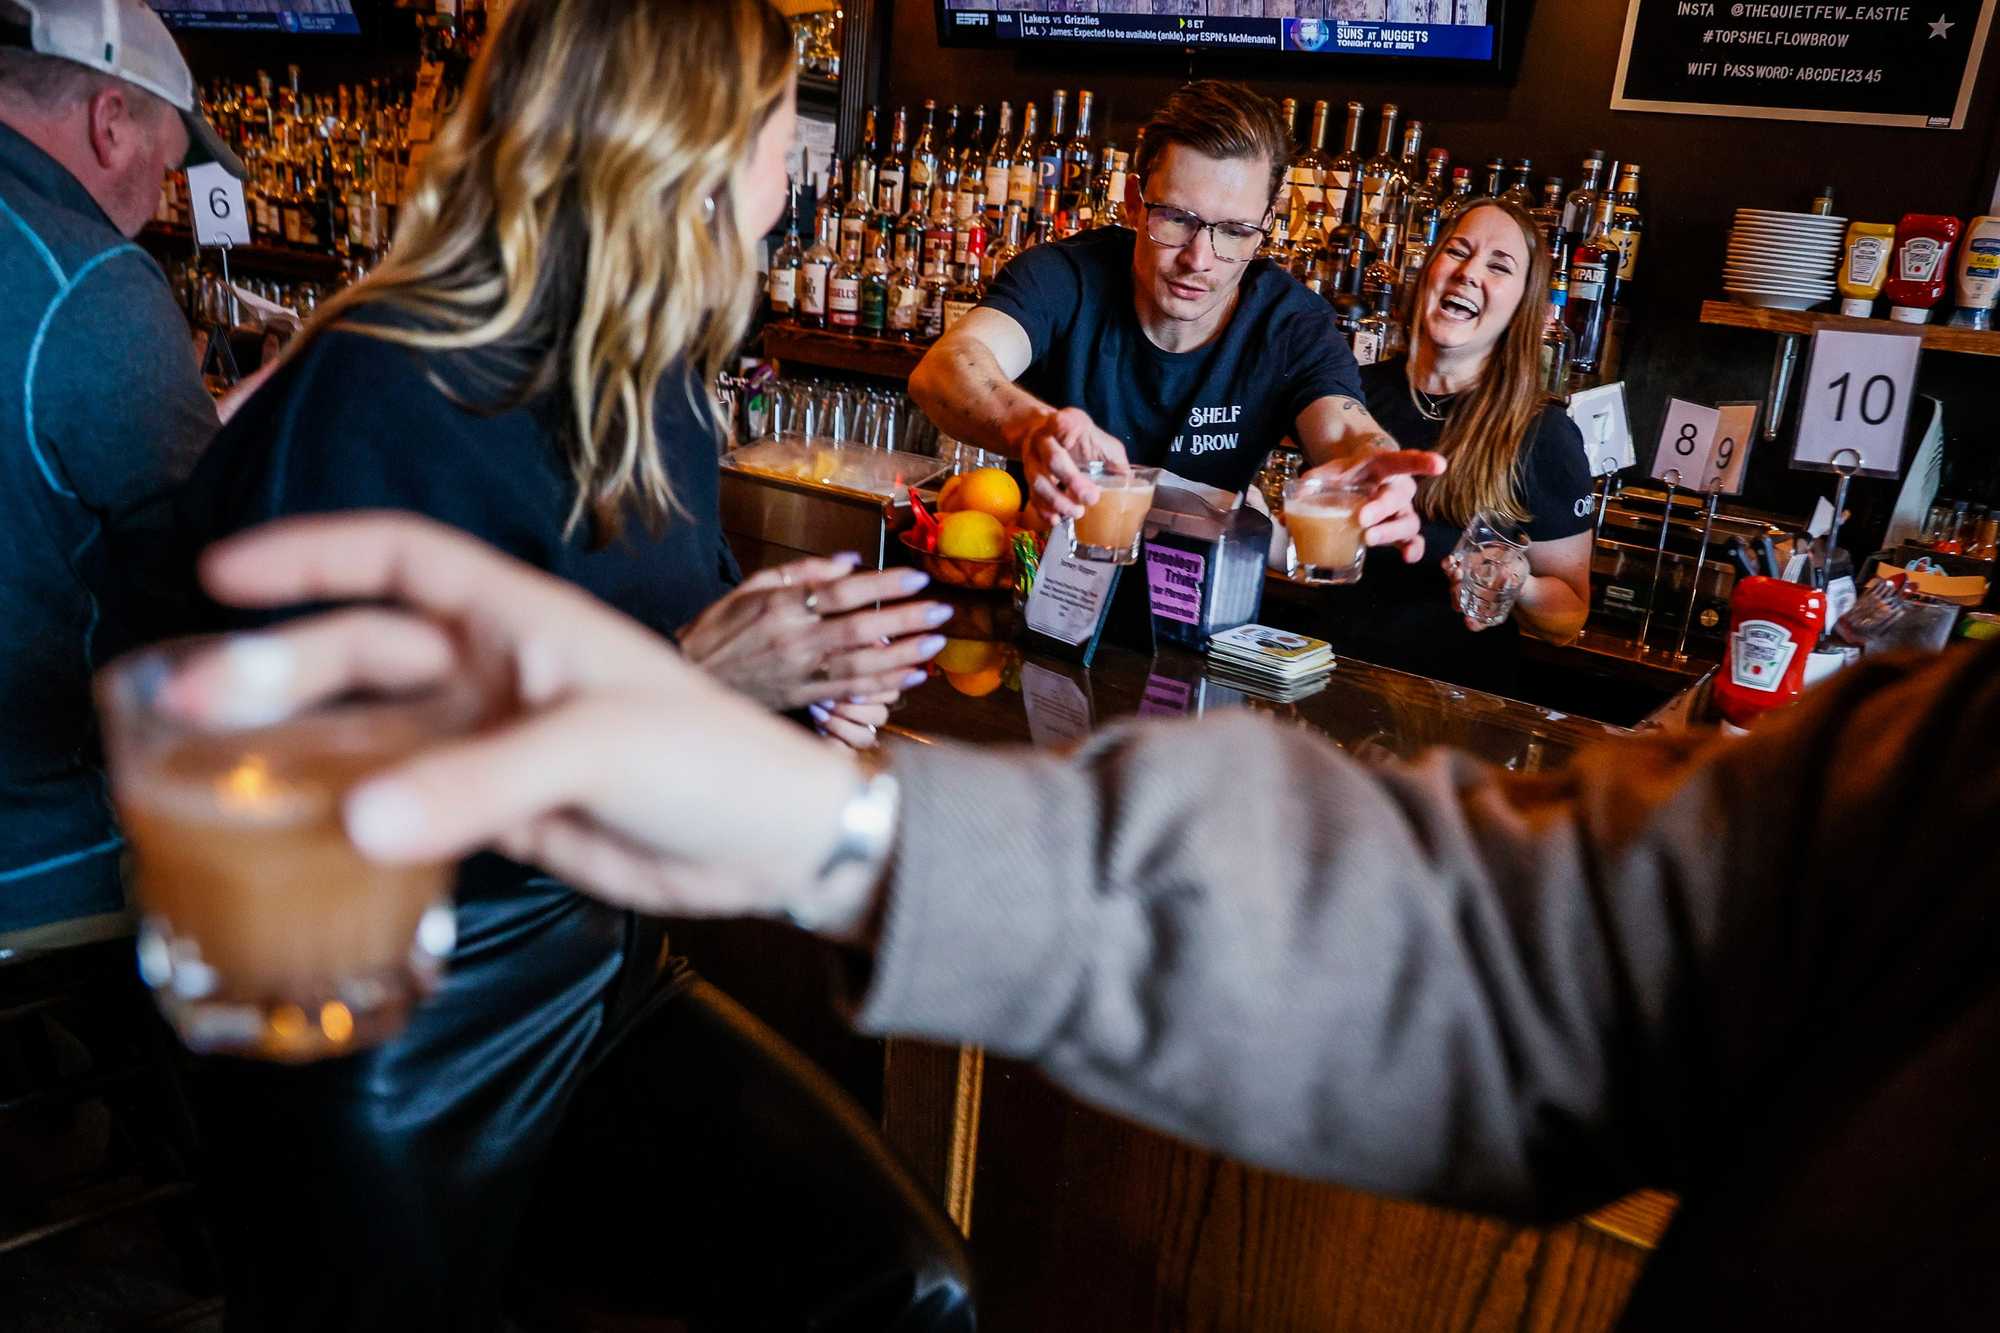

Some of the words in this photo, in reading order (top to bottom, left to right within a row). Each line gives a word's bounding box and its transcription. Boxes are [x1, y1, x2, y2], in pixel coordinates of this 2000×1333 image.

[955, 12, 989, 26] ESPN
[997, 14, 1012, 23] NBA
[1023, 14, 1050, 24] Lakers
[1053, 16, 1062, 24] vs
[1064, 15, 1100, 26] Grizzlies
[1677, 1, 1714, 17] INSTA
[1730, 3, 1910, 21] @THEQUIETFEW_EASTIE
[1187, 19, 1193, 29] 8
[1194, 20, 1204, 29] ET
[1025, 26, 1039, 36] LAL
[1049, 27, 1074, 37] James:
[1074, 28, 1106, 39] Expected
[1106, 29, 1114, 38] to
[1115, 30, 1125, 38] be
[1126, 30, 1157, 40] available
[1186, 33, 1199, 43] per
[1200, 32, 1228, 43] ESPN's
[1228, 33, 1276, 45] McMenamin
[1336, 28, 1364, 40] SUNS
[1367, 31, 1377, 41] AT
[1380, 29, 1429, 43] NUGGETS
[1336, 39, 1372, 48] TONIGHT
[1383, 41, 1394, 49] ET
[1395, 42, 1415, 50] ESPN
[1702, 29, 1850, 47] #TOPSHELFLOWBROW
[1687, 62, 1718, 76] WIFI
[1723, 63, 1794, 79] PASSWORD:
[209, 186, 230, 219] 6
[1828, 372, 1896, 426] 10
[1188, 405, 1242, 428] SHELF
[1592, 410, 1609, 445] 7
[1189, 432, 1239, 456] BROW
[1675, 423, 1698, 456] 8
[1715, 436, 1734, 470] 9
